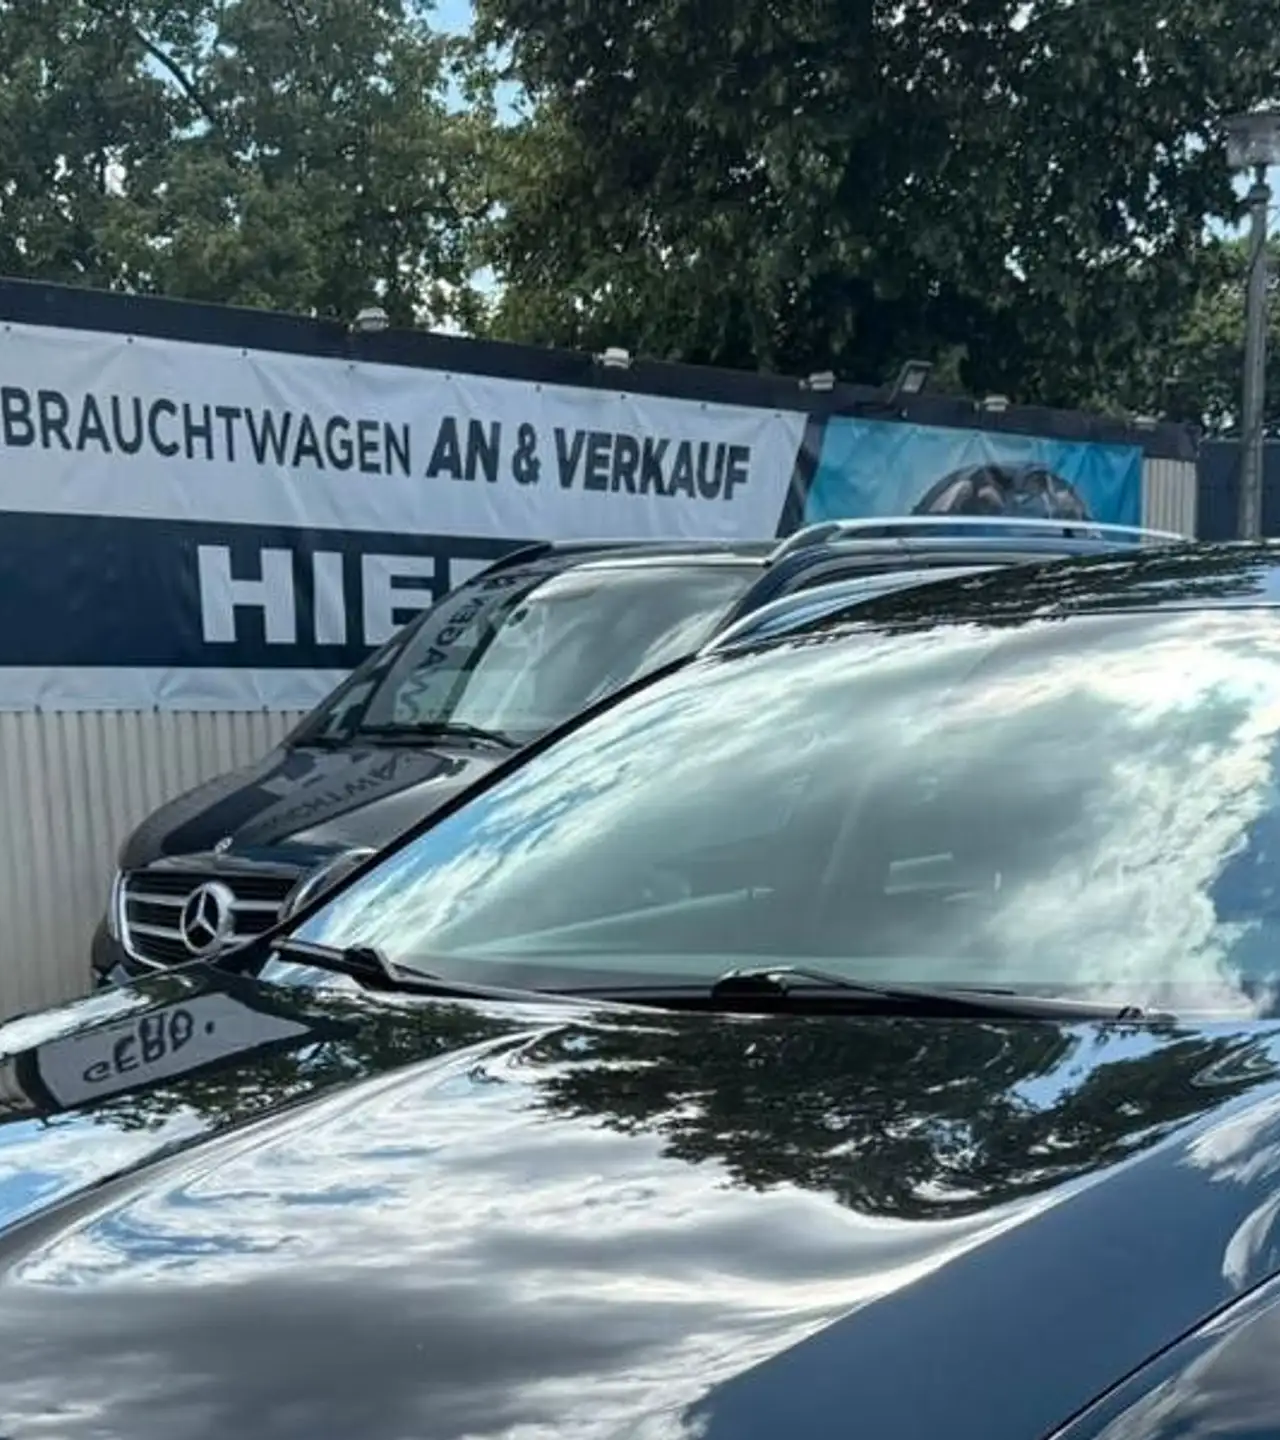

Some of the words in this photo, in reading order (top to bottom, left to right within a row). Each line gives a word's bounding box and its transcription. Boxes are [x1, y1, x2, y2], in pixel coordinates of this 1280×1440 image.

[426, 416, 501, 482] AN
[512, 422, 541, 485] &
[553, 427, 751, 501] VERKAUF
